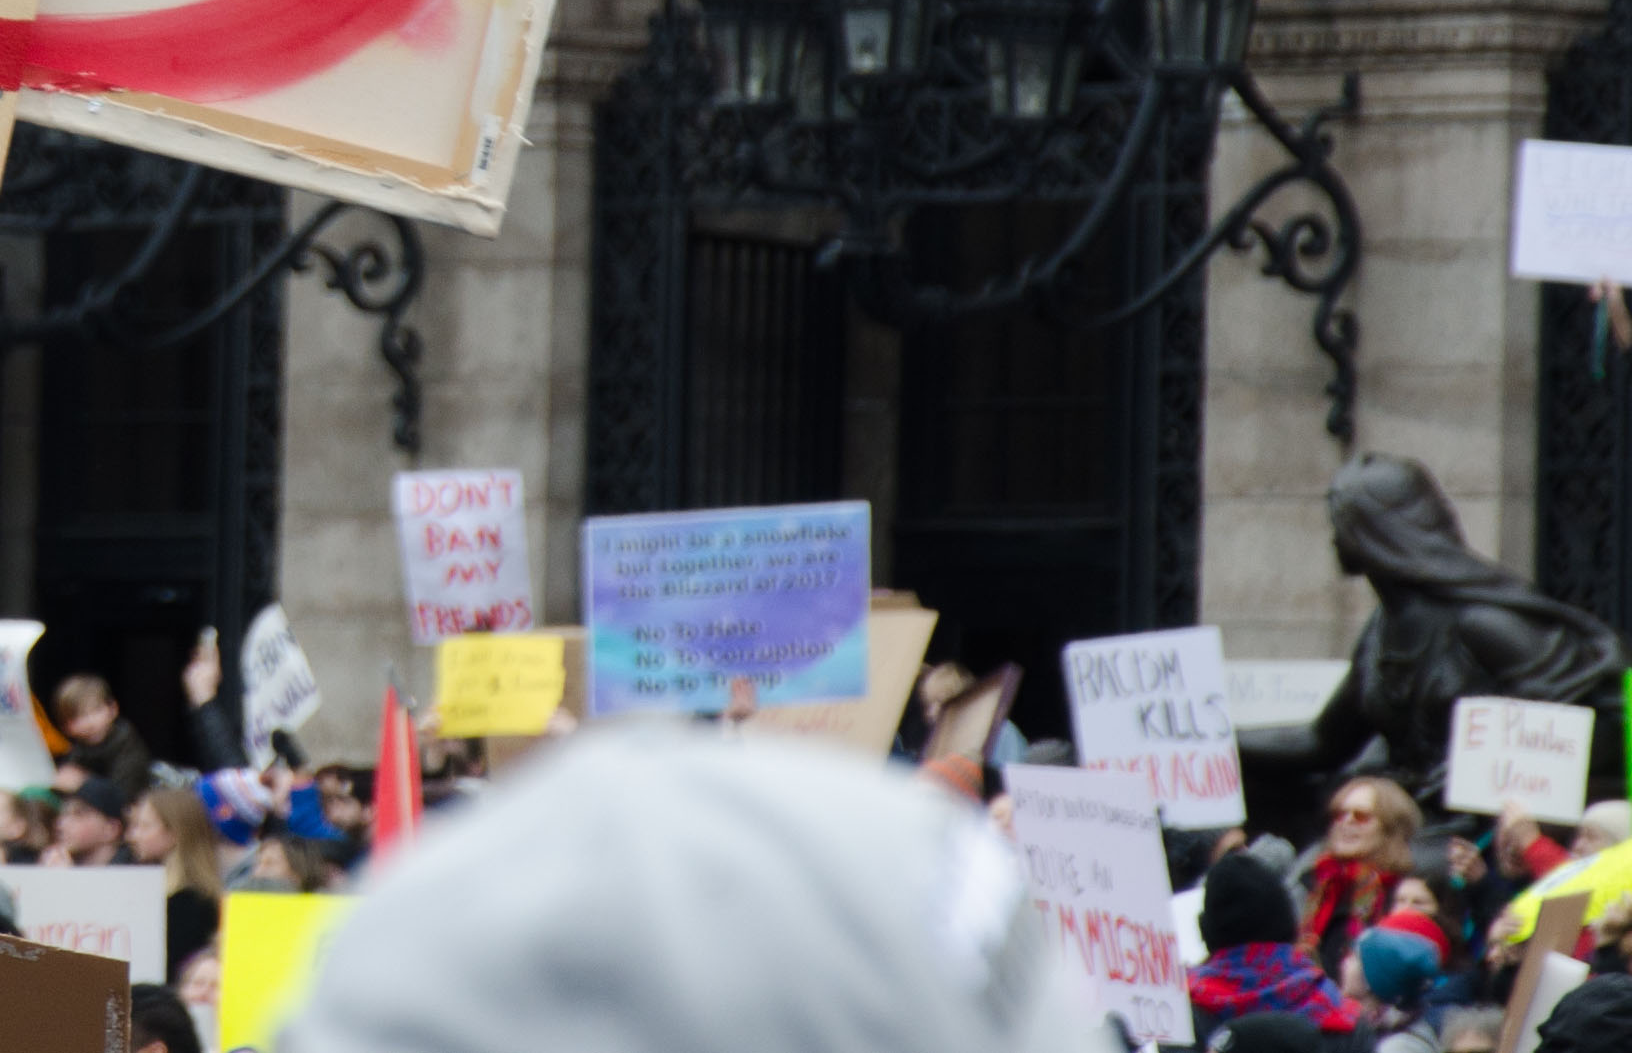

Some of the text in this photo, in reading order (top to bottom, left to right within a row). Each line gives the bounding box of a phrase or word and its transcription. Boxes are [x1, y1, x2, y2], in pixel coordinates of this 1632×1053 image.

[411, 474, 513, 517] DON'T
[424, 522, 503, 560] BAN
[619, 535, 680, 557] might
[691, 532, 712, 549] be
[744, 522, 852, 545] snowflake
[444, 558, 503, 586] MY
[617, 558, 651, 577] but
[768, 553, 795, 568] we
[803, 551, 841, 567] are
[619, 581, 652, 599] the
[755, 575, 779, 592] of
[785, 571, 838, 590] 2017
[633, 620, 761, 643] No To Hate
[635, 639, 835, 669] No To Corruption
[635, 676, 667, 694] No
[707, 670, 781, 691] Trmp
[1070, 647, 1186, 704] RACISM
[1137, 690, 1231, 741] KILLS
[1464, 706, 1492, 751] E
[1171, 748, 1240, 800] AGAIN
[23, 921, 133, 960] uman
